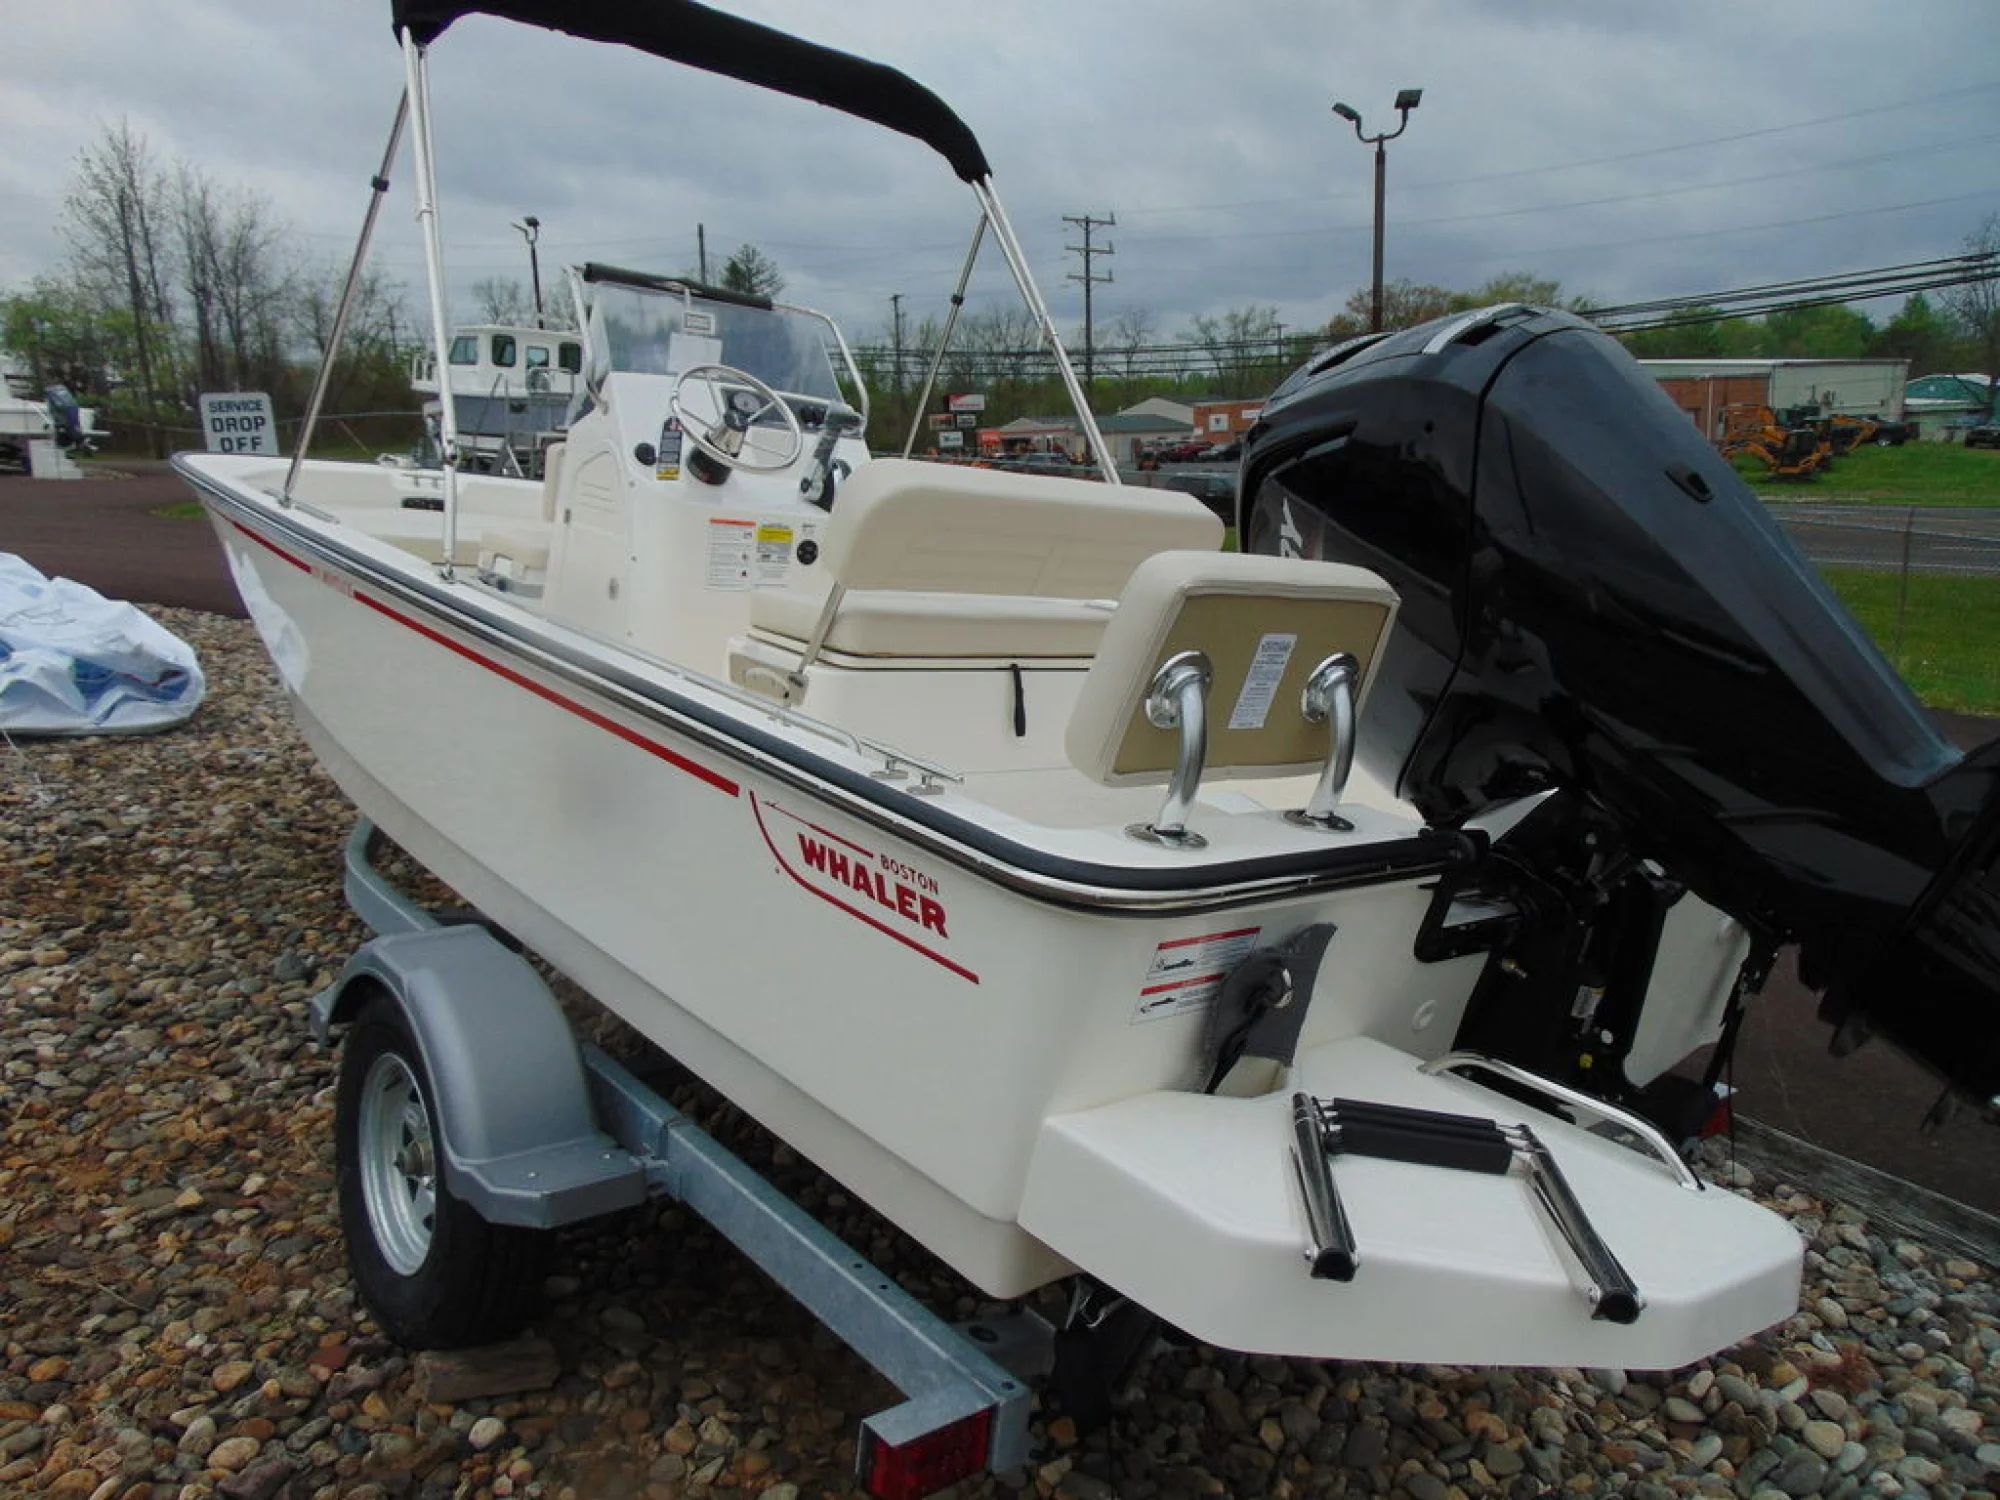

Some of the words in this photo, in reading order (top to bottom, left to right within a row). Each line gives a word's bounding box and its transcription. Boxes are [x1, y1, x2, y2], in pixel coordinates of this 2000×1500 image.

[208, 399, 264, 412] SERVICE
[210, 415, 266, 433] DROP
[220, 436, 263, 452] OFF
[880, 854, 938, 894] BOSTON
[797, 832, 948, 939] WHALER
